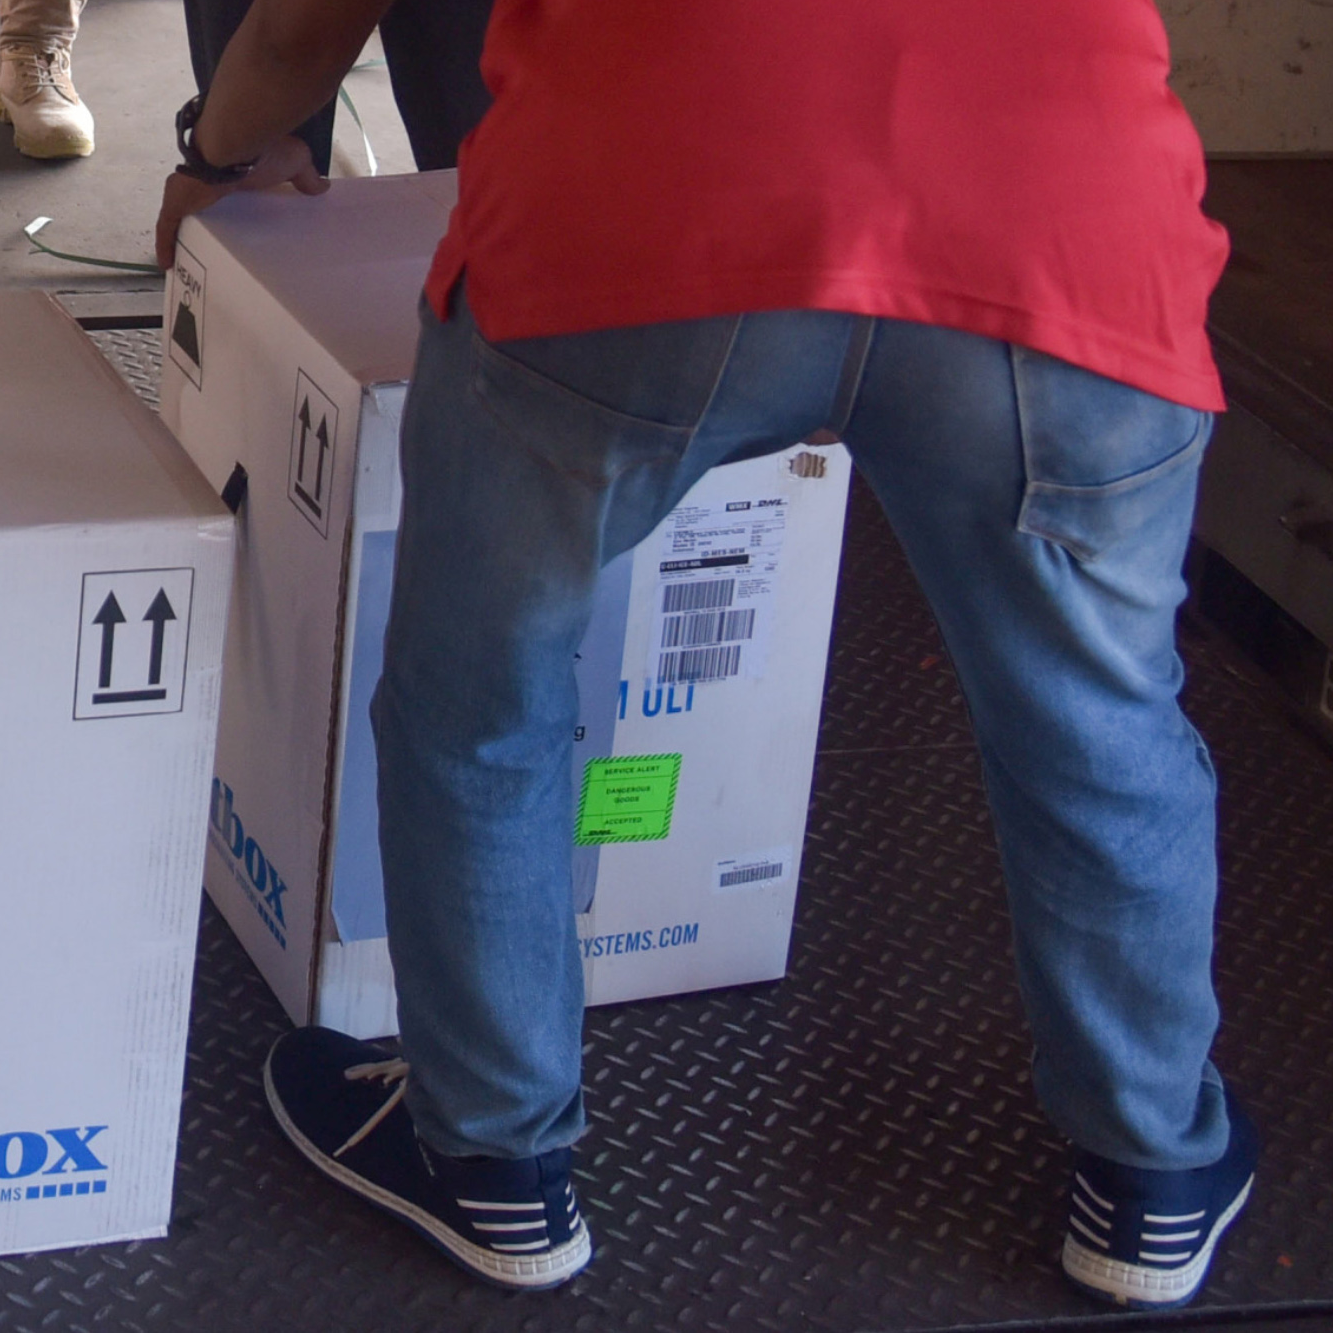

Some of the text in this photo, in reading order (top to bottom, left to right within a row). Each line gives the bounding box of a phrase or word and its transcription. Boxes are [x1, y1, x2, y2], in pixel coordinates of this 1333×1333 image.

[175, 261, 202, 298] HEAVY
[604, 765, 660, 776] SERVICE ALERT
[606, 785, 651, 795] DANGEROUS
[604, 816, 643, 826] ACCEPTED
